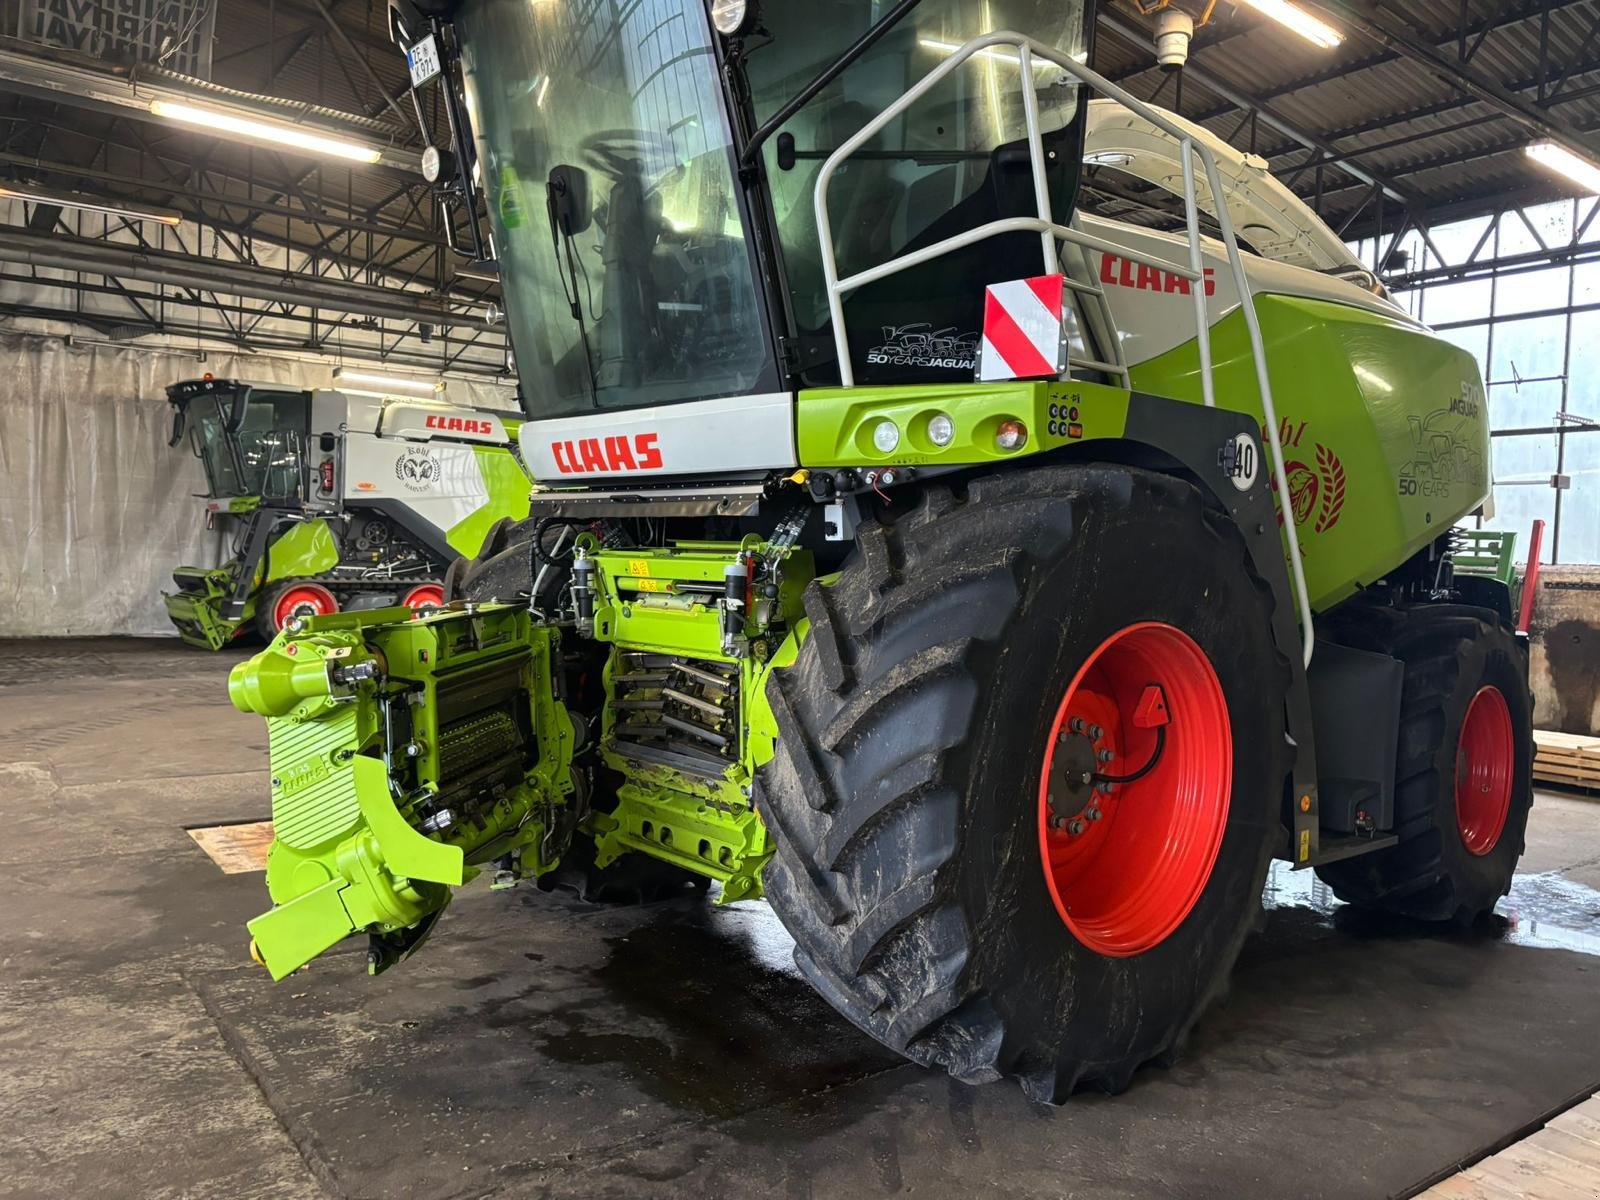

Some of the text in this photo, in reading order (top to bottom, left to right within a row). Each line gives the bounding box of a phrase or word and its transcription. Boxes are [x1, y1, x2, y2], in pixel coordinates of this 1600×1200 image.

[1100, 252, 1215, 296] CLAAS
[425, 415, 492, 434] CLAAS
[1449, 397, 1478, 418] JAGUAR
[551, 432, 663, 473] CLAAS
[1235, 443, 1253, 479] 40
